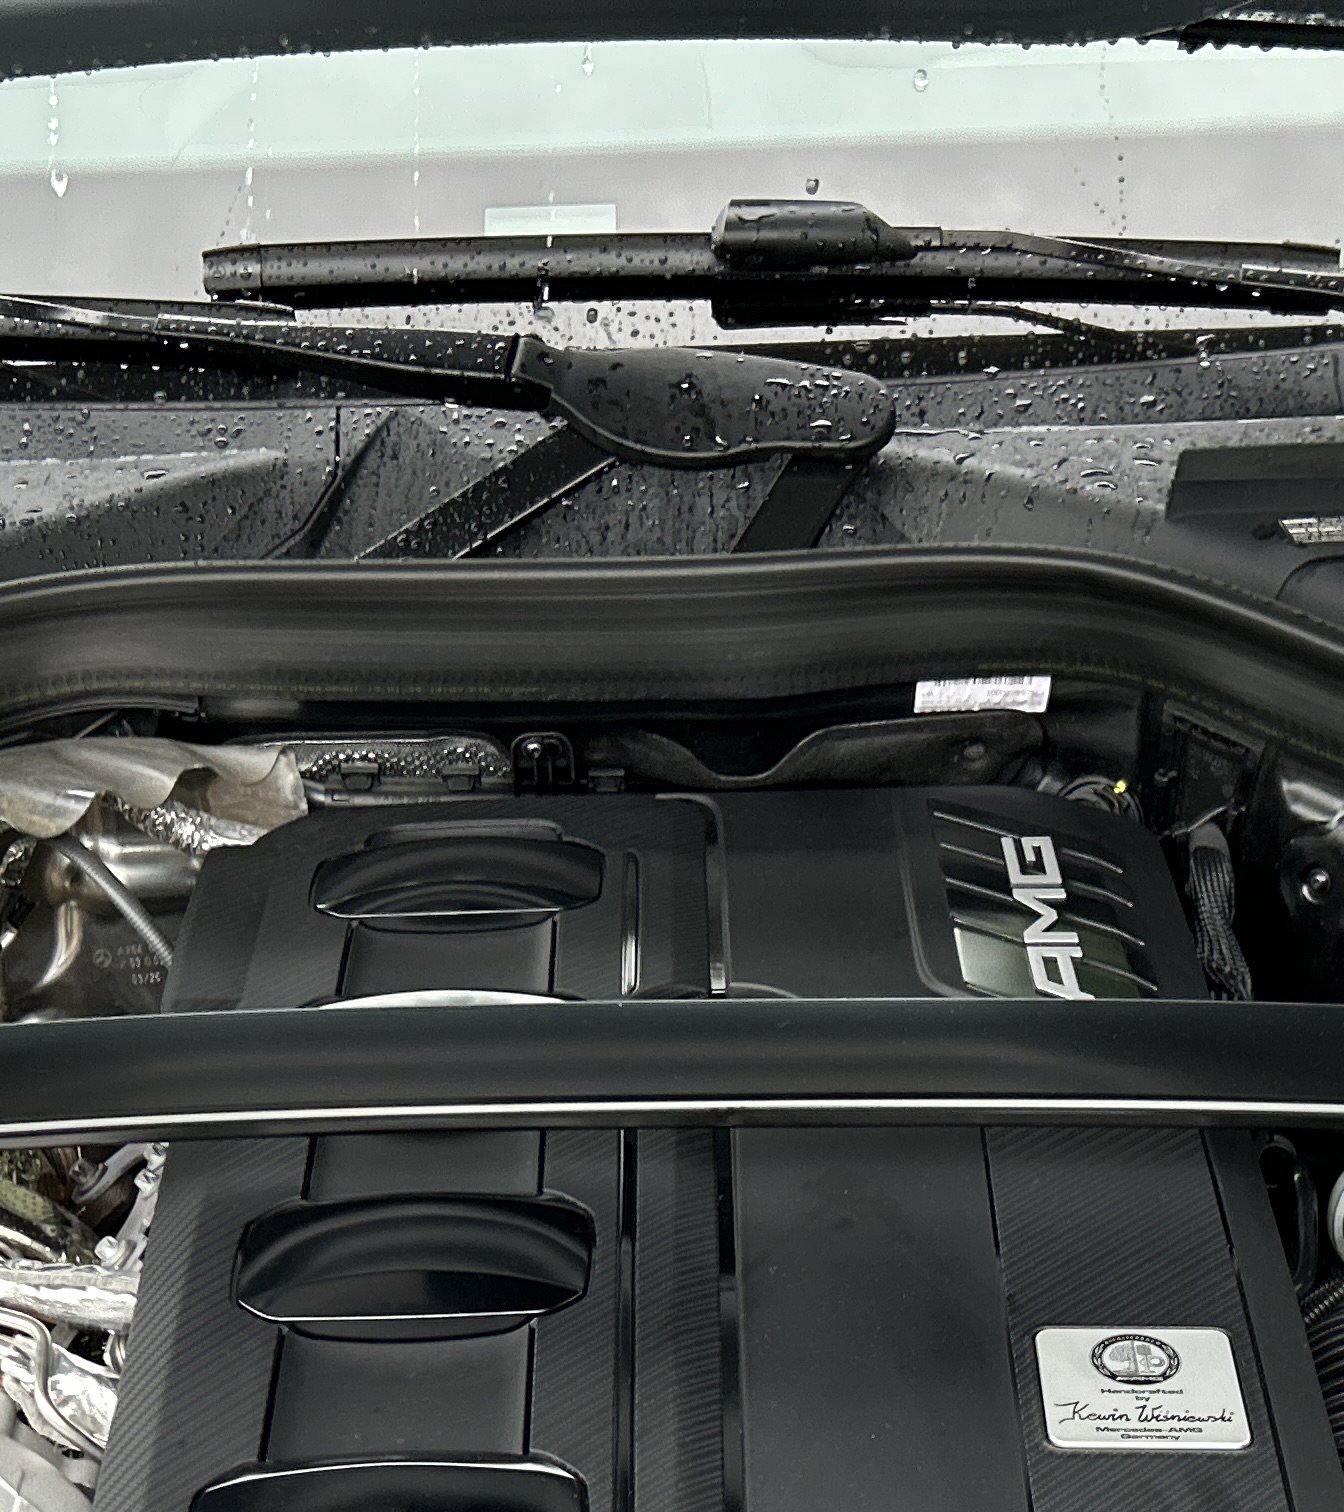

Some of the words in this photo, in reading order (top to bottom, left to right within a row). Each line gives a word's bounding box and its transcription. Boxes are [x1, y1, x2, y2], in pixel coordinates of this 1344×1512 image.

[1000, 836, 1096, 1001] AMG
[1100, 1387, 1184, 1395] Handcrafted
[1120, 1433, 1182, 1441] Germany
